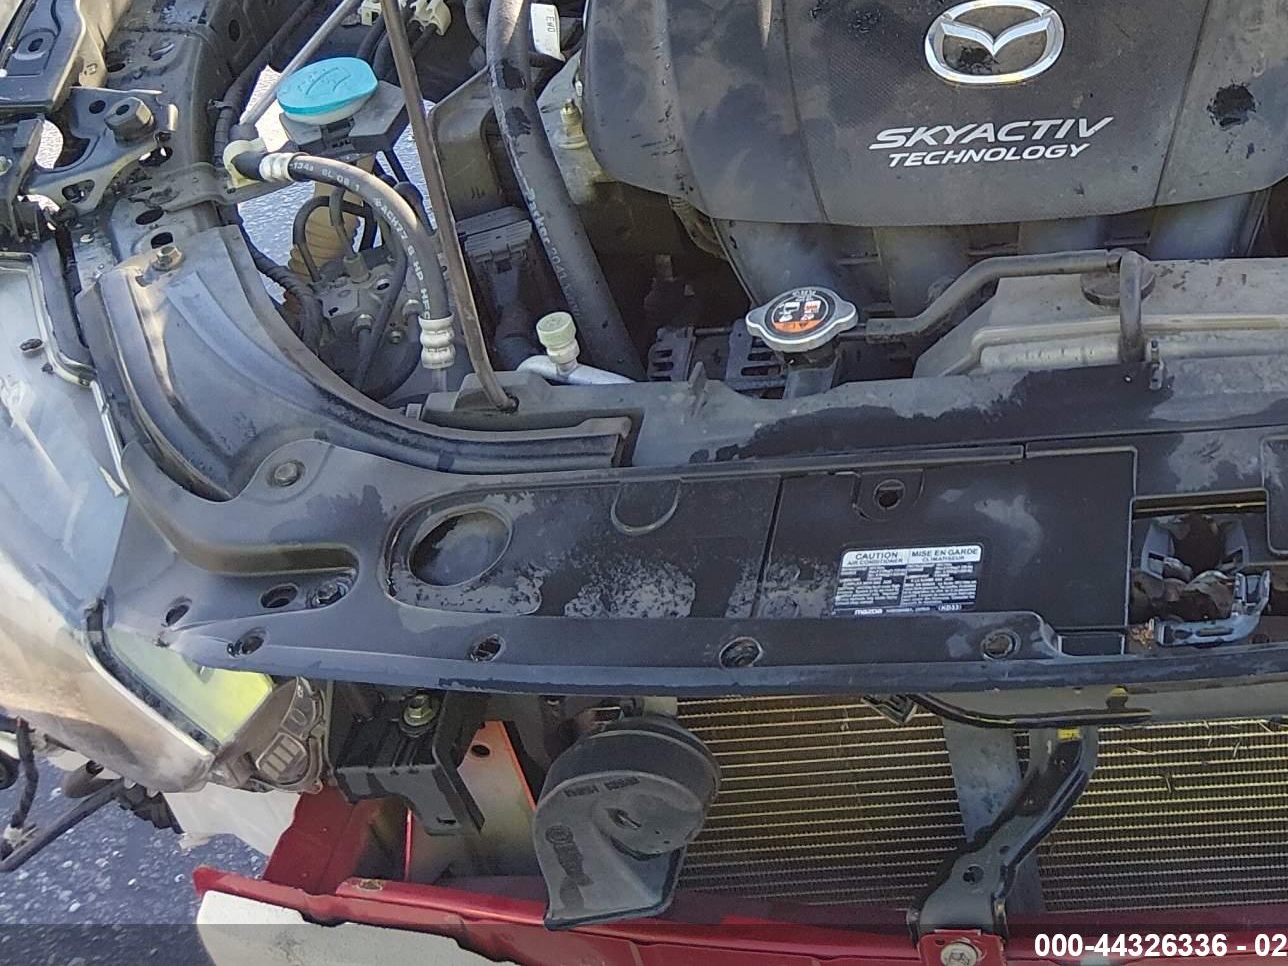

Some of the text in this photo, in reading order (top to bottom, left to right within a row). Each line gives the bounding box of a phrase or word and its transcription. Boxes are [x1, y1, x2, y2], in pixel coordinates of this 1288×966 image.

[869, 117, 1113, 150] SKYACTIV
[889, 144, 1090, 168] TECHNOLOGY
[855, 551, 898, 560] CAUTION
